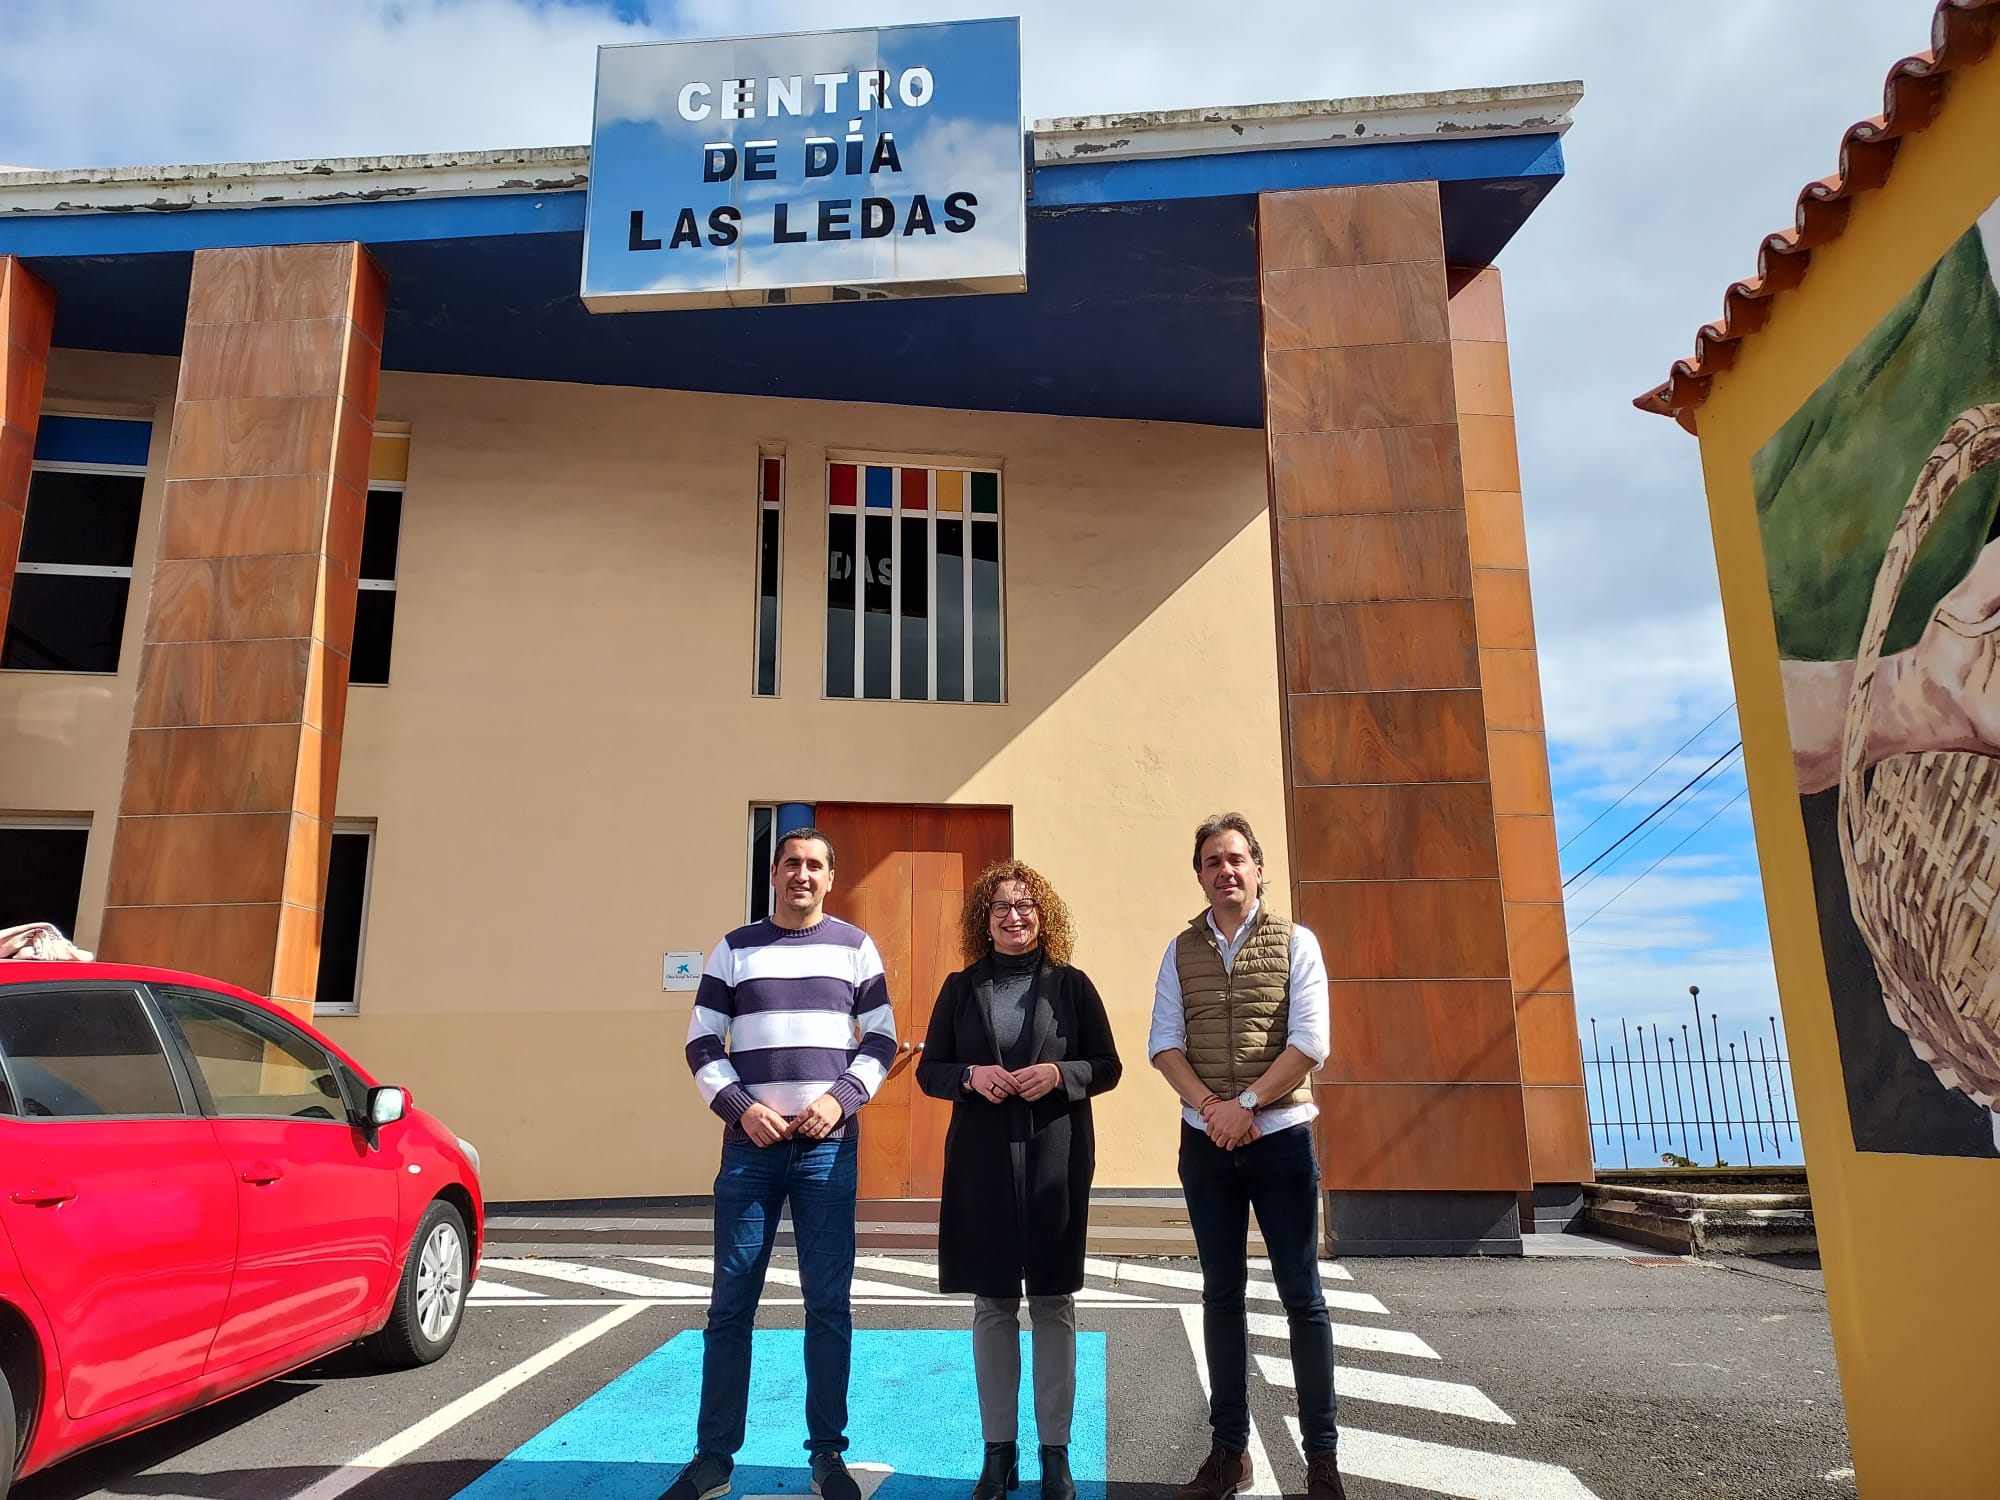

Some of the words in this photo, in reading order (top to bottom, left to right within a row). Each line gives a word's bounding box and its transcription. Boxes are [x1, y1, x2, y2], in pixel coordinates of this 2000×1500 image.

[677, 66, 935, 121] CENTRO
[703, 139, 778, 183] DE
[804, 116, 903, 178] DÍA
[628, 205, 742, 251] LAS
[773, 191, 979, 244] LEDAS
